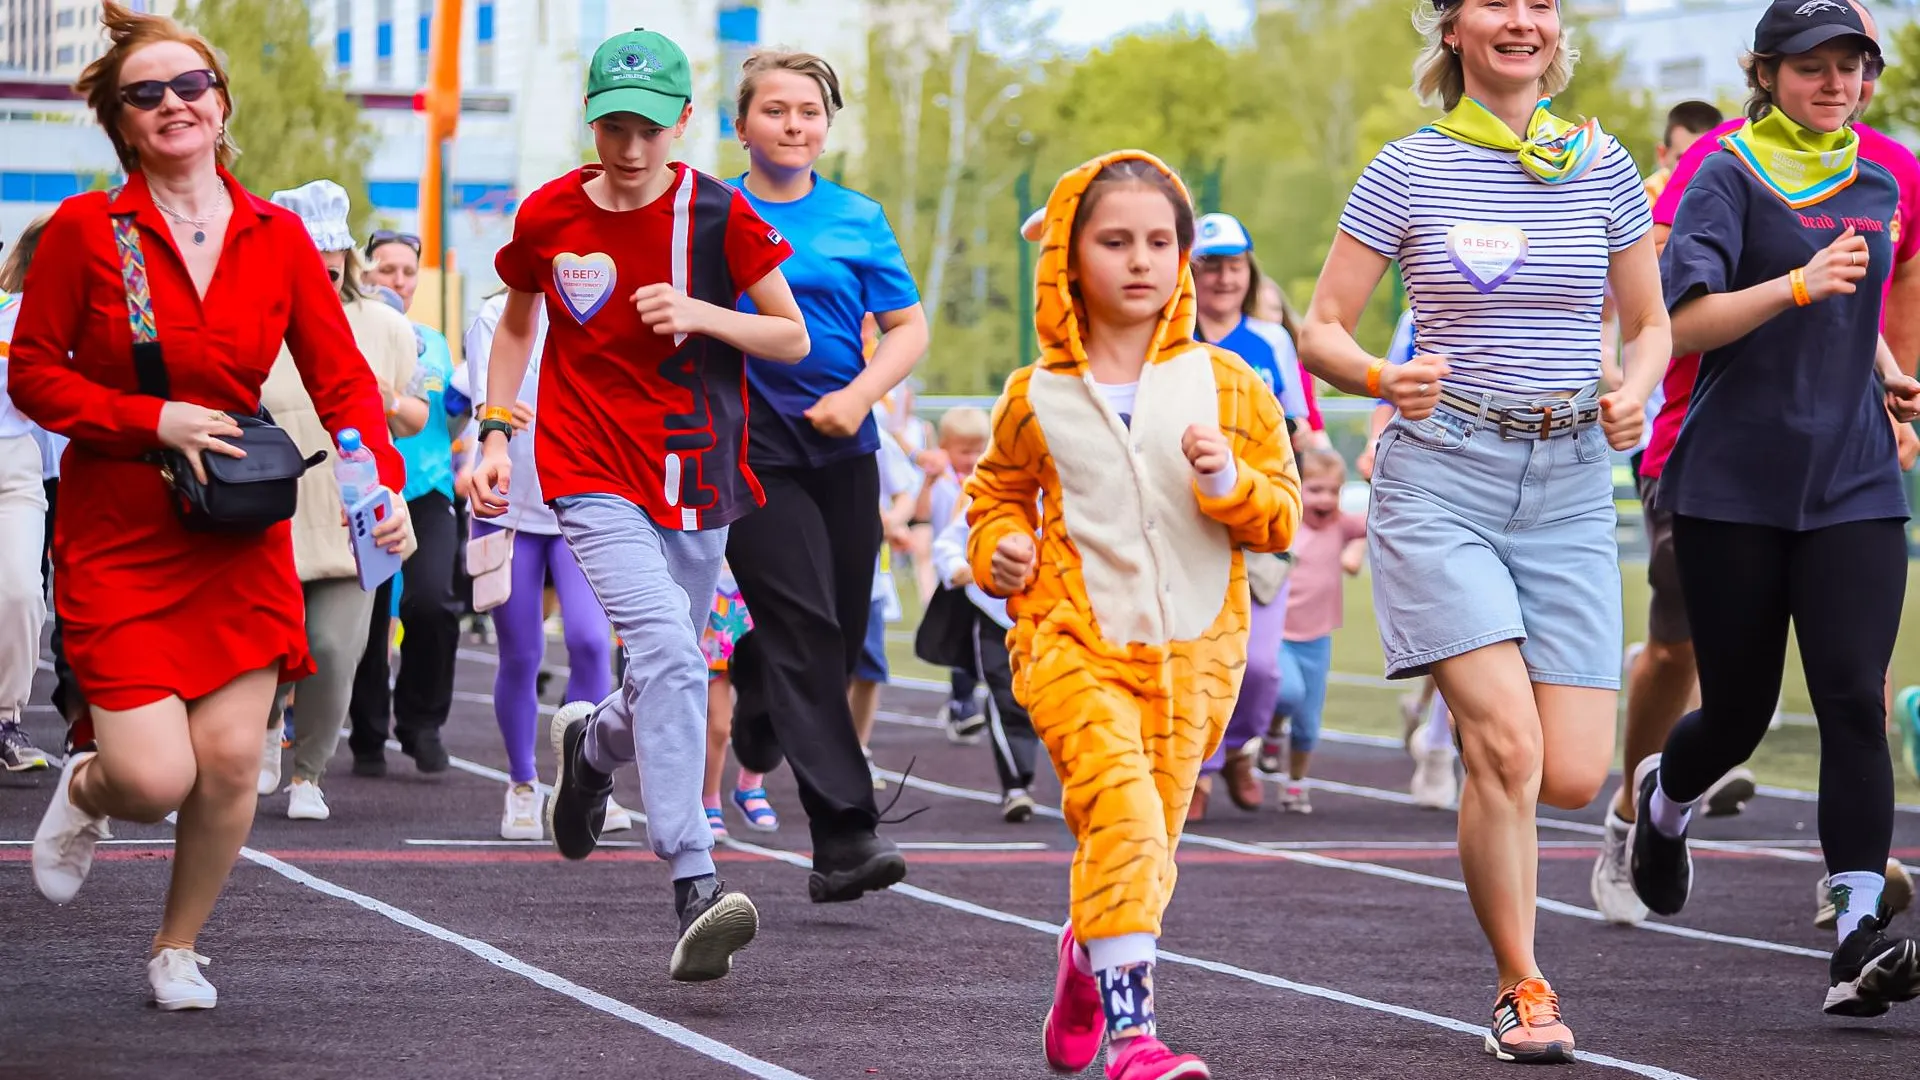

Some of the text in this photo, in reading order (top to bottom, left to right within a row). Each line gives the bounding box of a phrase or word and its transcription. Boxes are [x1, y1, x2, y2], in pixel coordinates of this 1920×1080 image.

[1797, 213, 1836, 229] dead
[1463, 238, 1472, 247] Я
[563, 270, 604, 279] Я БЕГУ-
